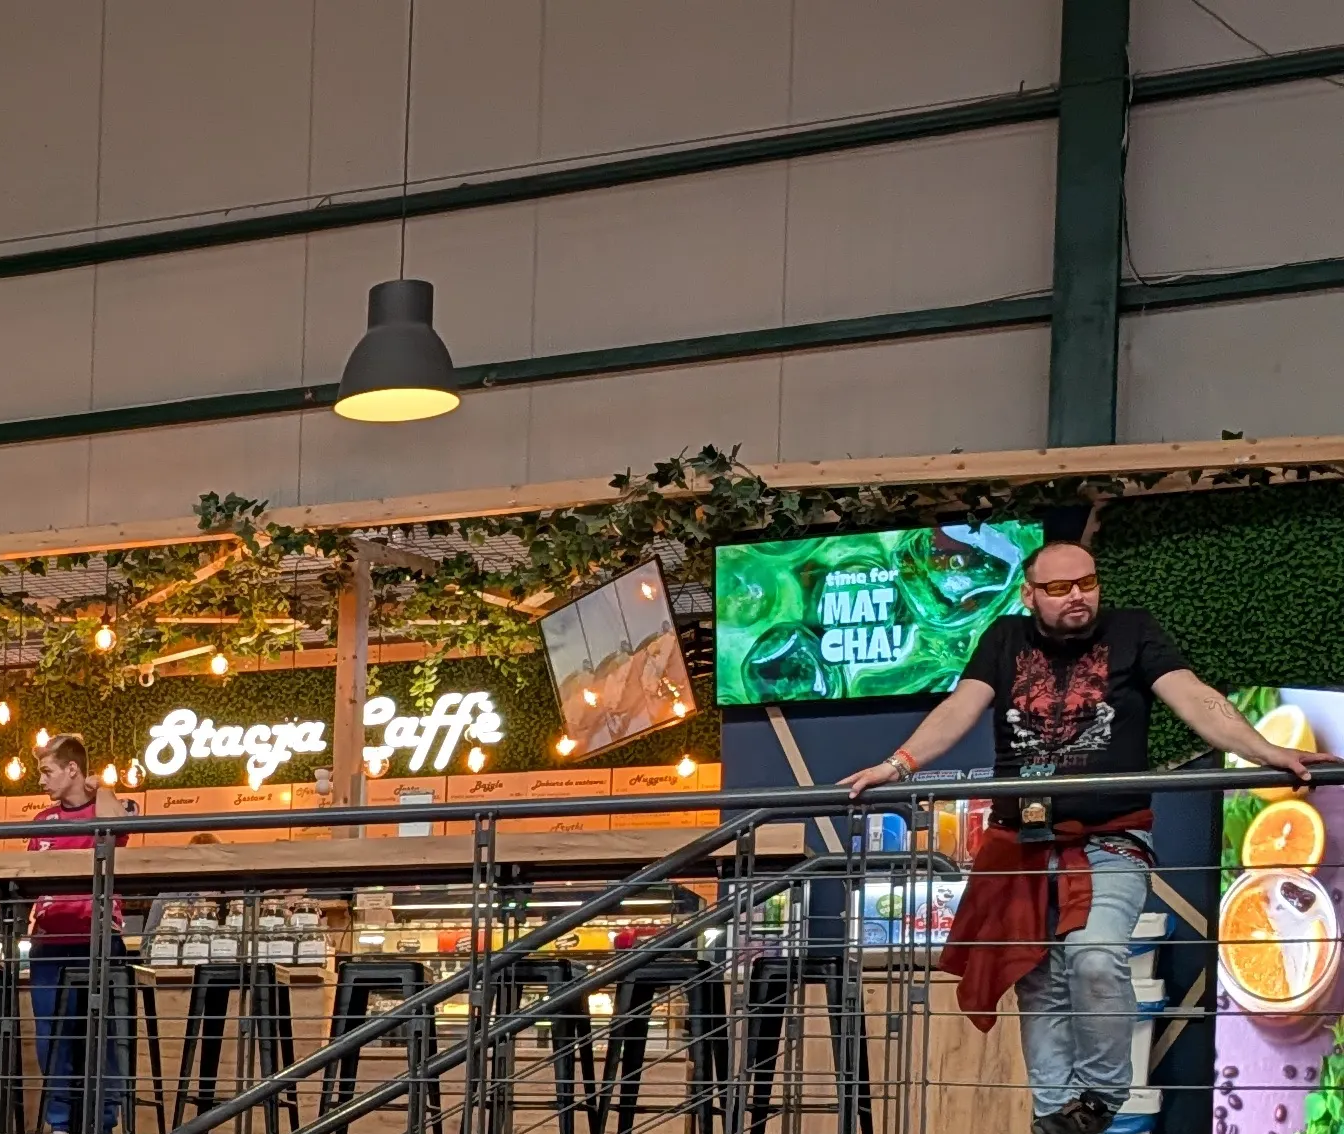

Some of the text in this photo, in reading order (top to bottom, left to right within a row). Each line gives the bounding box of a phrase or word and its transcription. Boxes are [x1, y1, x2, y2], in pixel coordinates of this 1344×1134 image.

[826, 567, 899, 587] time for
[823, 588, 894, 625] MAT
[820, 625, 902, 663] CHA!
[145, 708, 327, 778] Stacja
